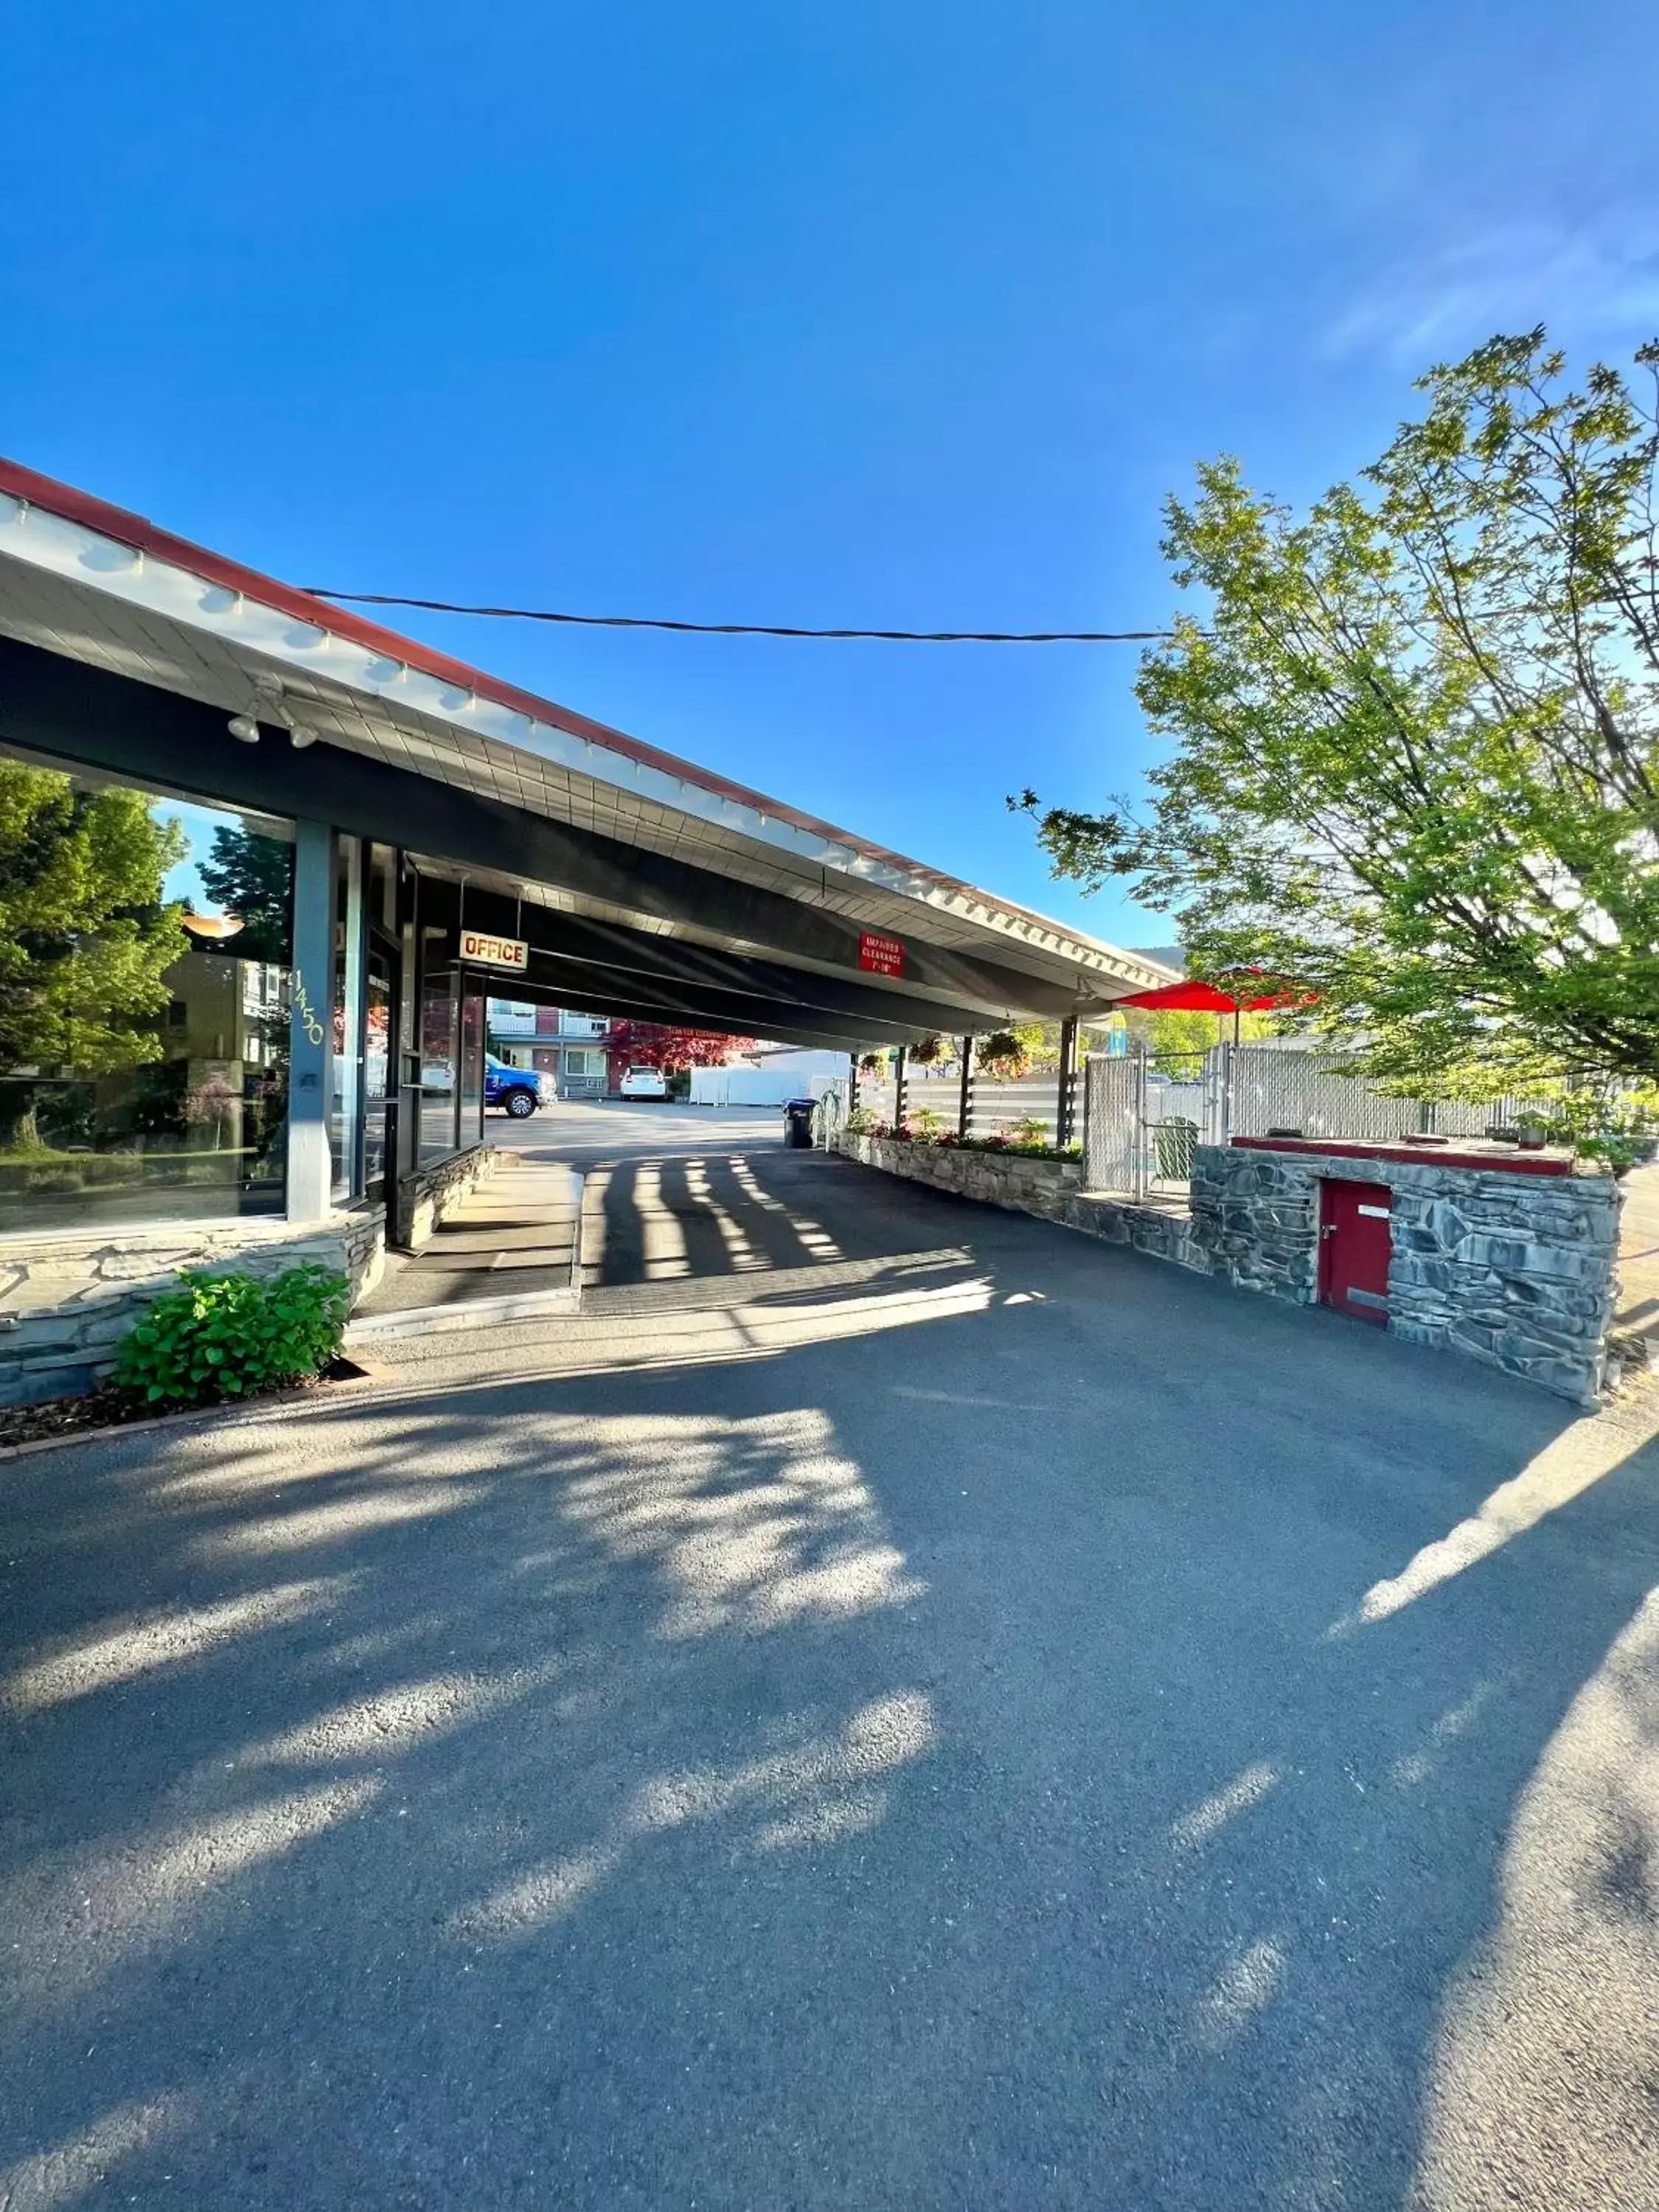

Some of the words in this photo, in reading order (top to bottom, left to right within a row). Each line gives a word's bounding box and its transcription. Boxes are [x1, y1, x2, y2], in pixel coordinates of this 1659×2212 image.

[465, 937, 523, 962] OFFICE
[862, 947, 901, 964] CLEARANCE
[295, 969, 324, 1046] 1450
